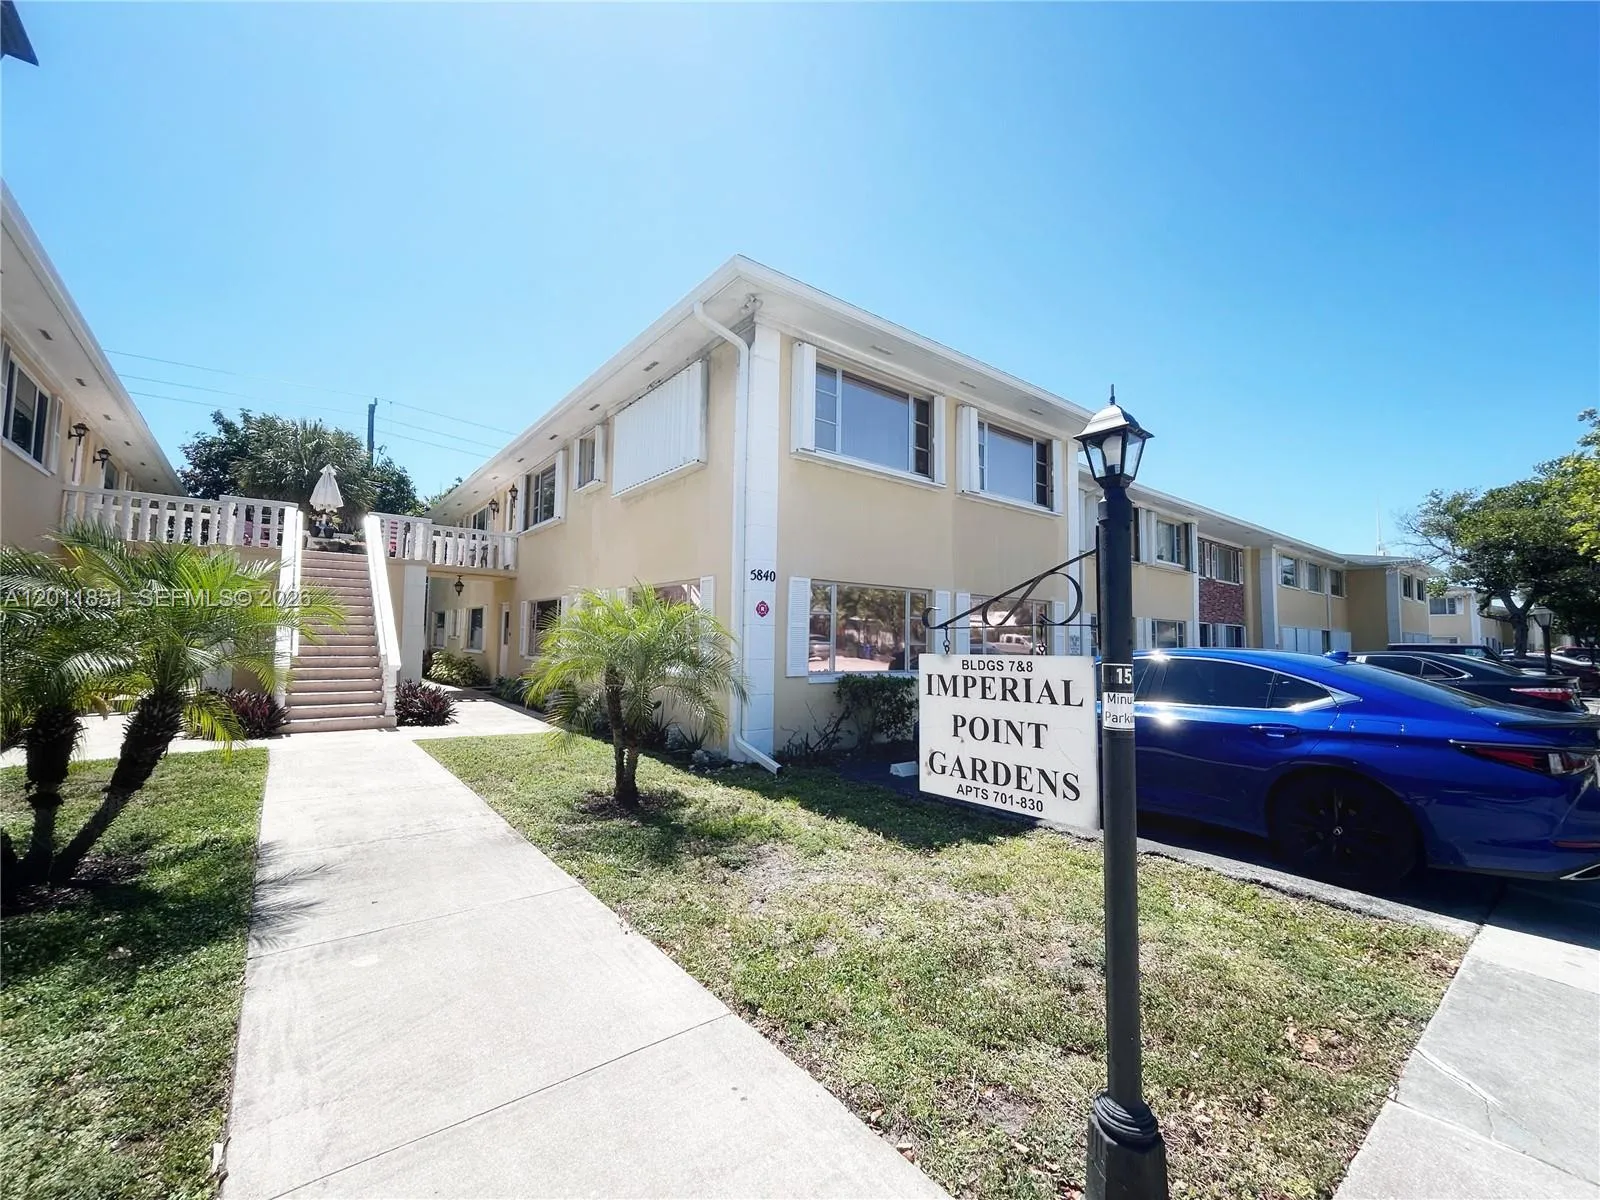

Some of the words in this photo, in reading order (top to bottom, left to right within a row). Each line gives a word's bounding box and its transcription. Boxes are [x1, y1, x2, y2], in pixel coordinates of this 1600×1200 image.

[750, 569, 776, 582] 5840
[961, 659, 1004, 672] BLDGS
[1008, 661, 1034, 673] 7&8
[1116, 667, 1133, 685] 15
[925, 673, 1084, 708] IMPERIAL
[1107, 692, 1134, 705] Minu
[951, 714, 1048, 749] POINT
[928, 750, 1081, 802] GARDENS
[956, 783, 989, 801] APTS
[992, 790, 1044, 813] 701-830
